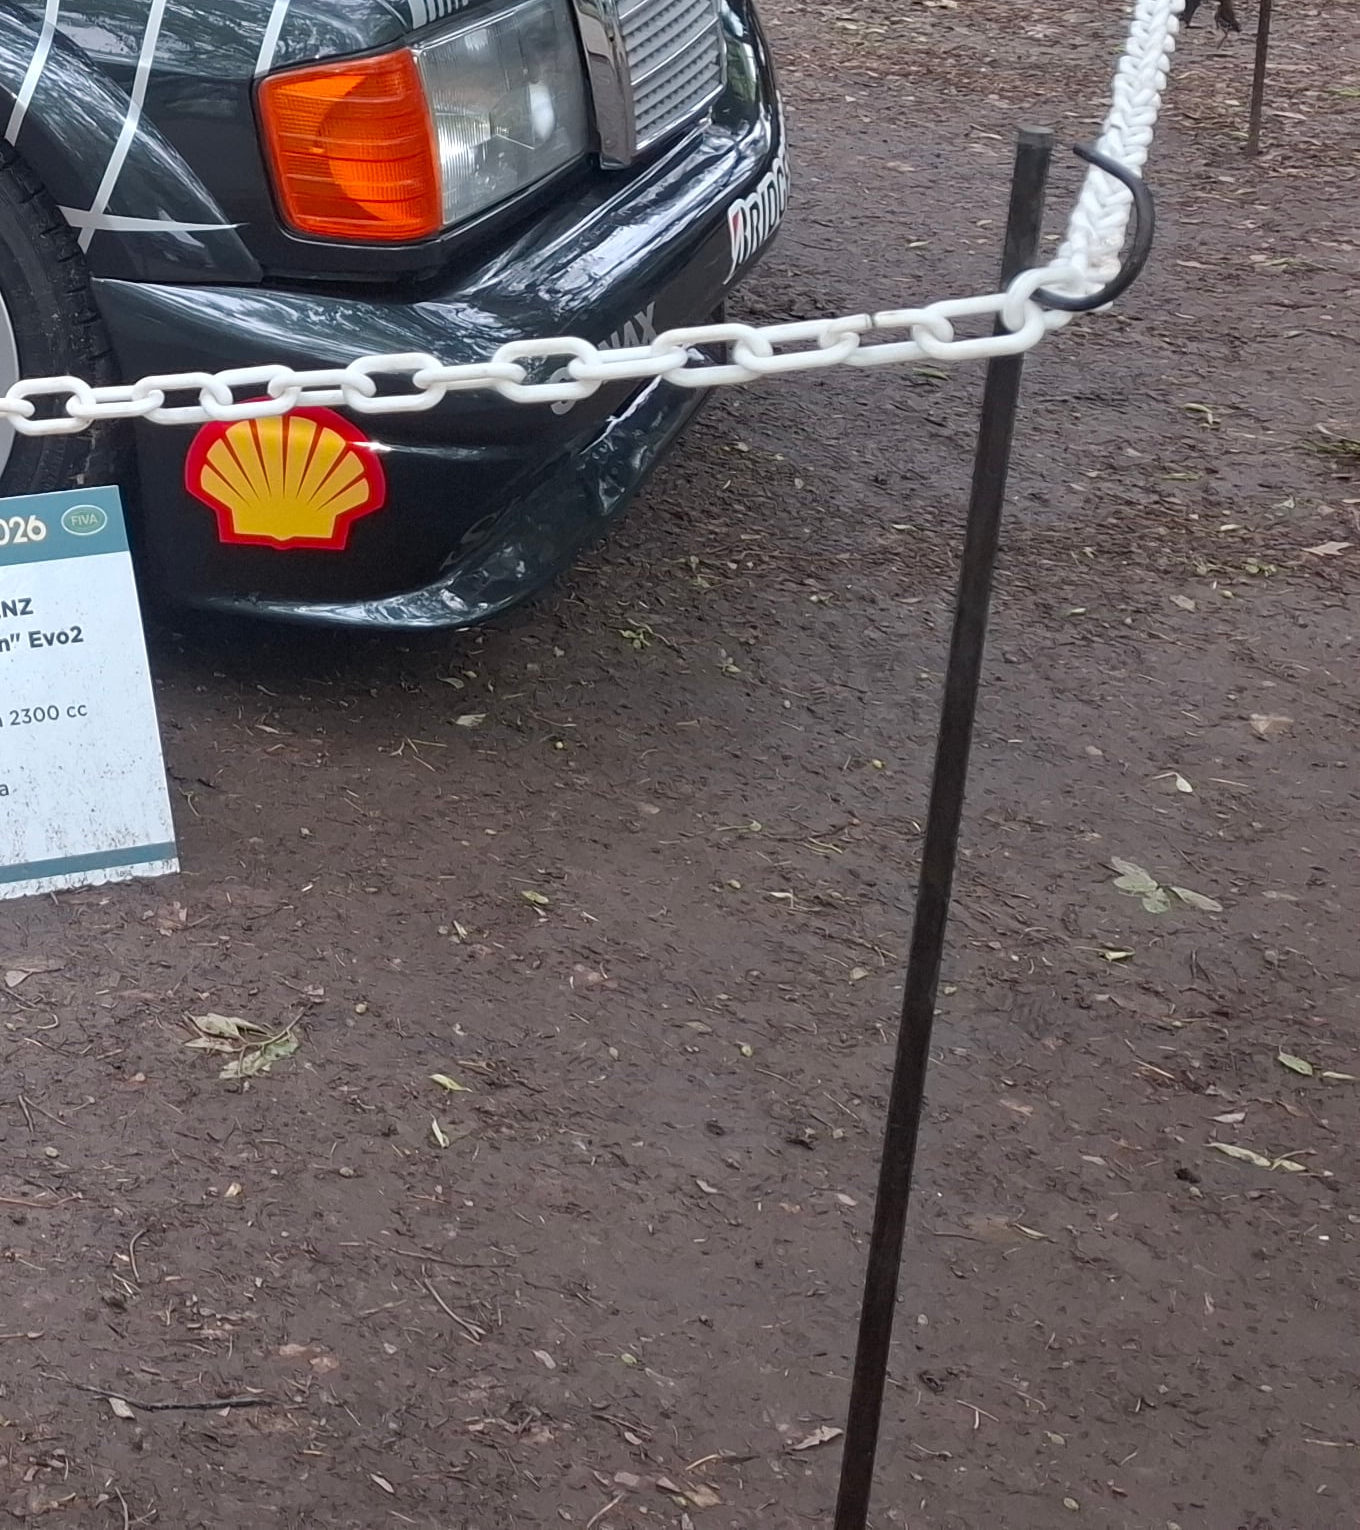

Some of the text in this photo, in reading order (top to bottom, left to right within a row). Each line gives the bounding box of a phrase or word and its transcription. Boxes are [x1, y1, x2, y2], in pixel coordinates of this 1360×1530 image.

[546, 301, 657, 415] SAX
[70, 512, 98, 527] FIVA
[29, 626, 84, 649] Evo2
[10, 705, 60, 727] 2300
[67, 706, 87, 718] cc
